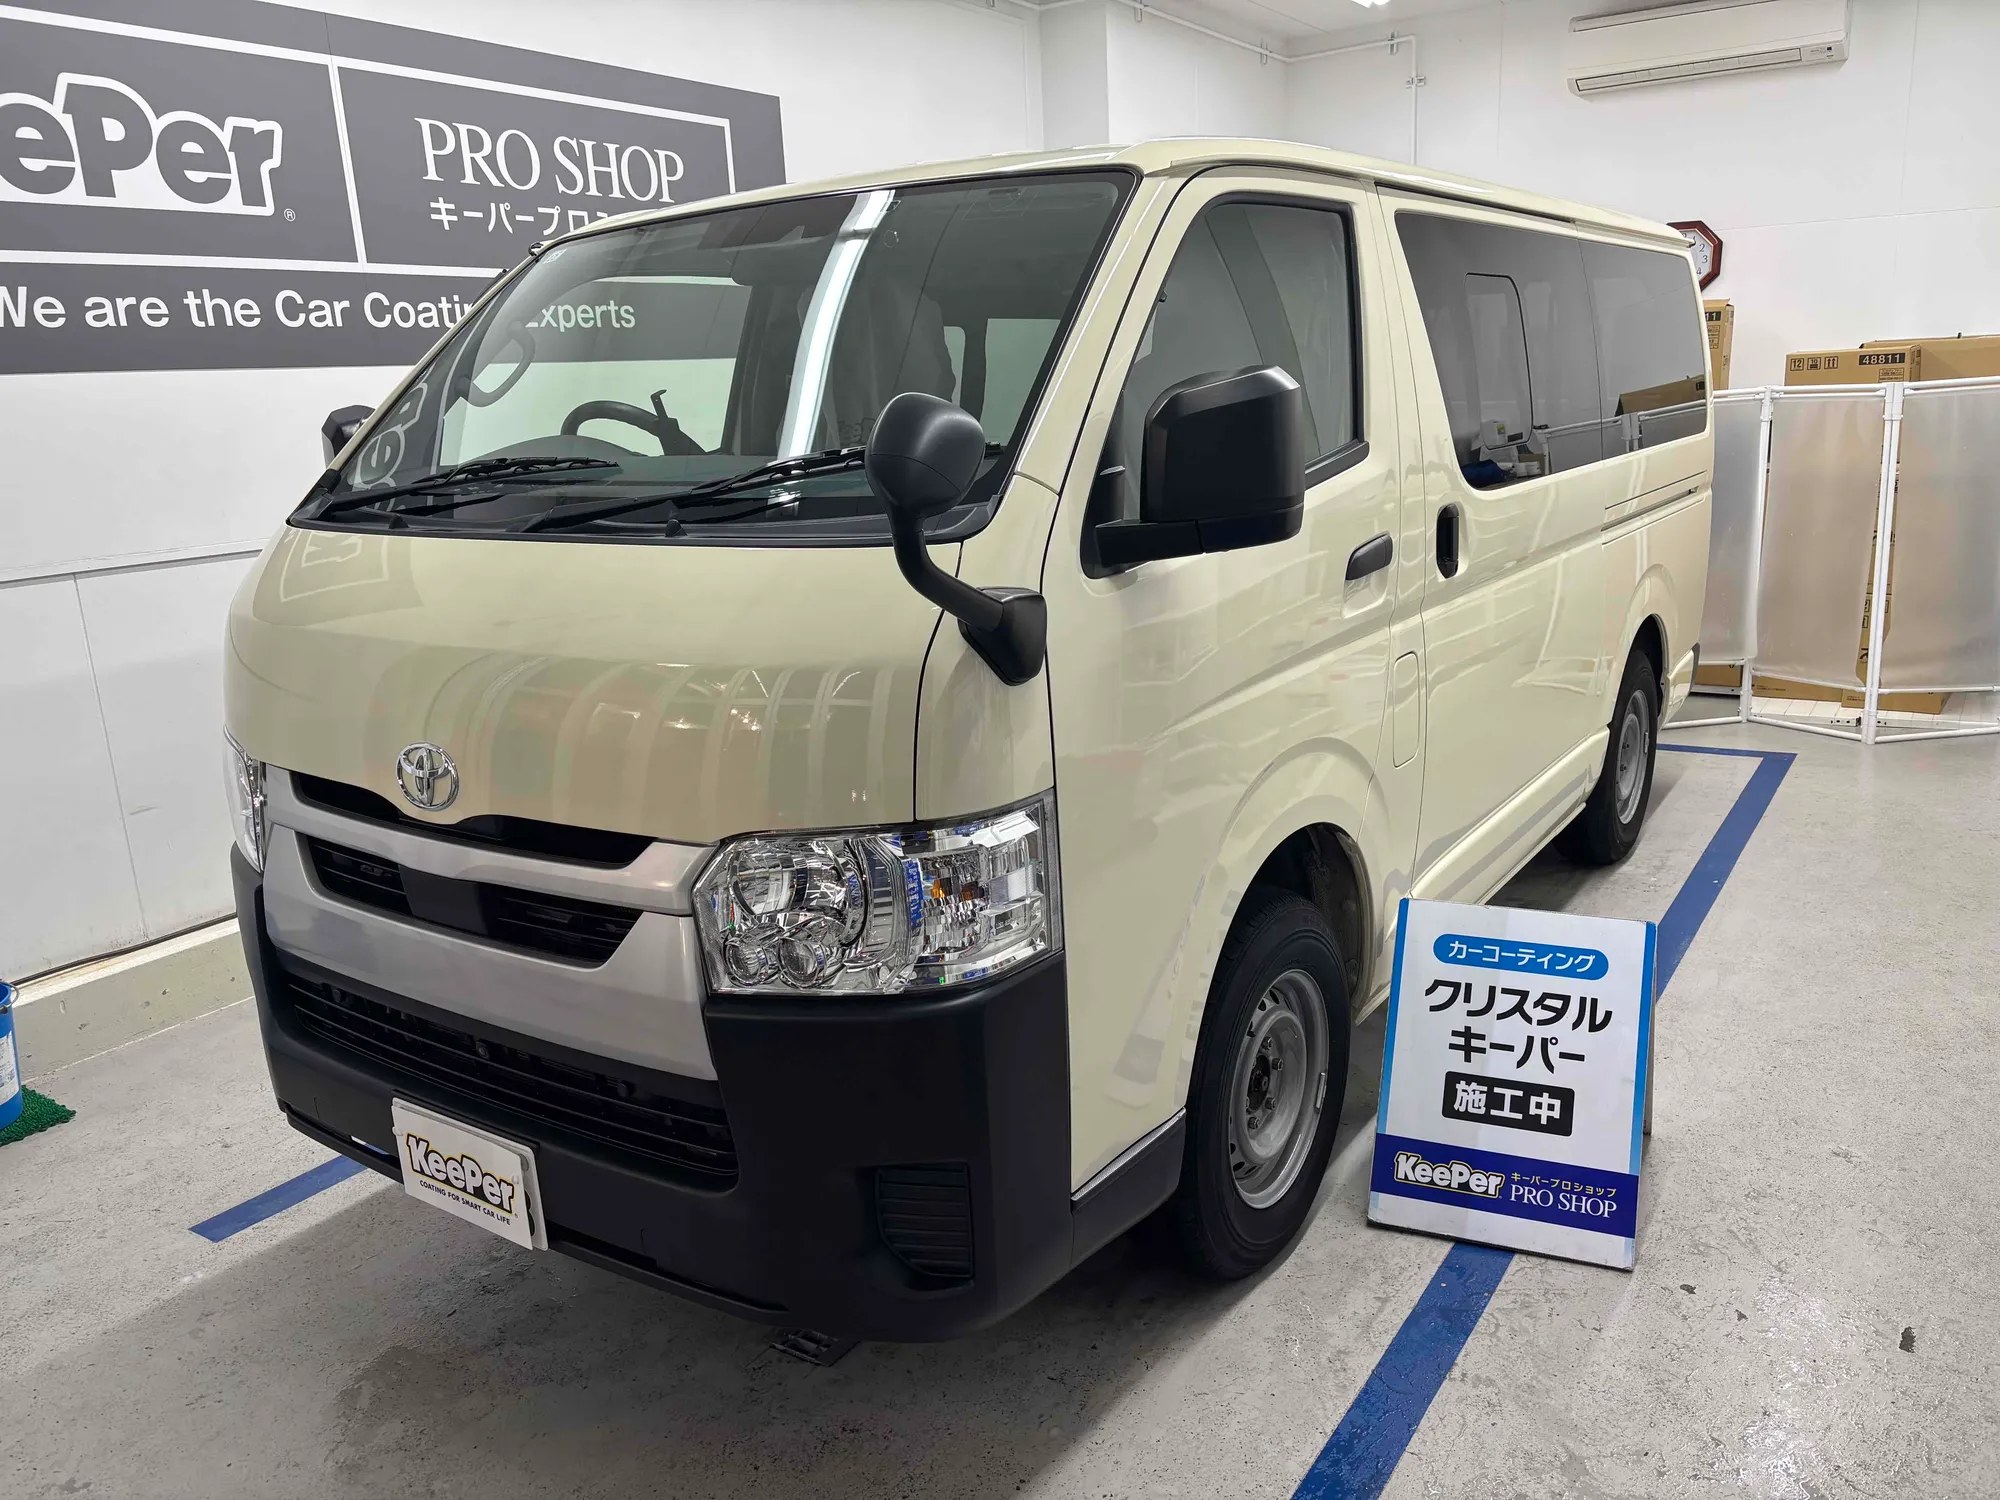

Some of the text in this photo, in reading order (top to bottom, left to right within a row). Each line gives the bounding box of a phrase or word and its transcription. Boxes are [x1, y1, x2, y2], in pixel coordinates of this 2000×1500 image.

[414, 117, 684, 203] PRO SHOP
[430, 196, 608, 236] キーパープロ
[1699, 243, 1706, 253] 2
[1701, 254, 1708, 263] 3
[84, 296, 170, 328] are
[183, 288, 263, 328] the
[275, 289, 350, 328] Car
[363, 291, 473, 329] Coati
[1792, 359, 1802, 369] 12
[1863, 353, 1900, 365] 48811
[1448, 940, 1596, 973] カーコーティング
[1425, 979, 1613, 1033] クリスタル
[1448, 1025, 1585, 1074] キーパー
[1453, 1080, 1562, 1125] 施工中
[406, 1132, 515, 1214] KeePer
[1394, 1151, 1505, 1198] KeePer
[1510, 1172, 1617, 1198] キーパープロショップ
[419, 1179, 511, 1226] COATING FOR SMART CAR LIFE
[1509, 1184, 1618, 1218] PRO SHOP
